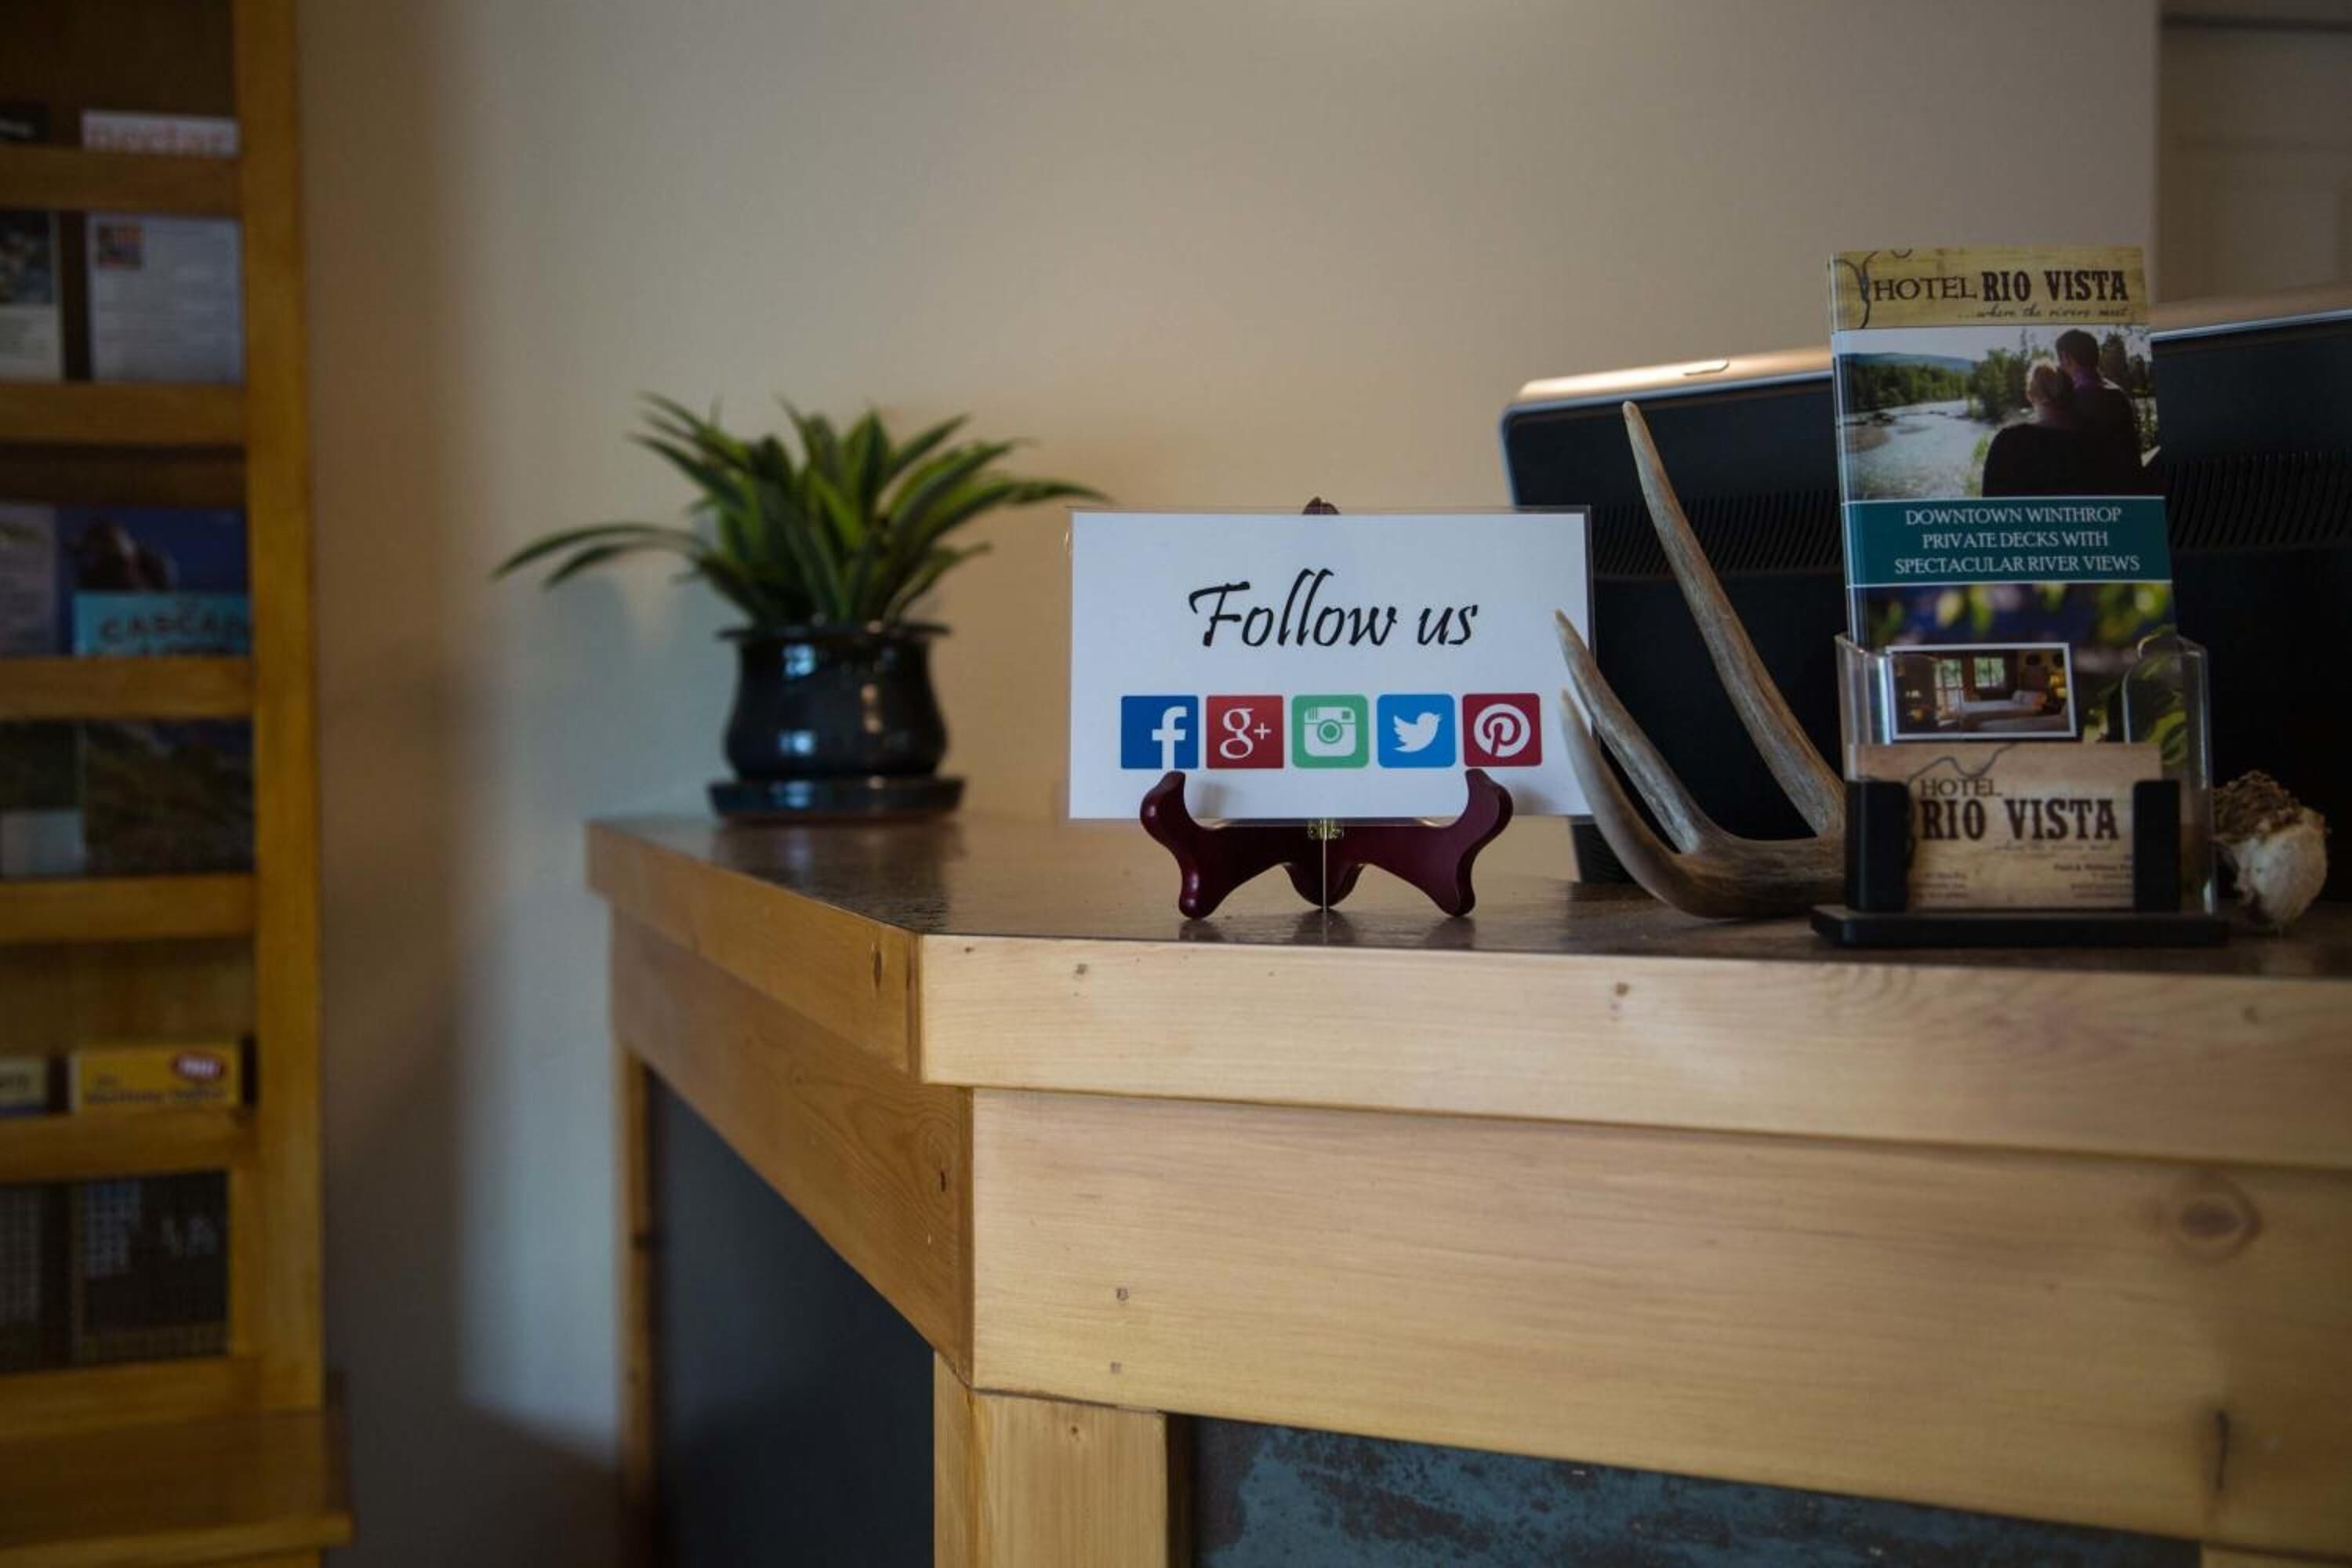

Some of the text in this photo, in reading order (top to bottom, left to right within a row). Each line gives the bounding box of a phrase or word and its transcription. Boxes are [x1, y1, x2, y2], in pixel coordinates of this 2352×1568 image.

[1874, 270, 2129, 302] HOTEL RIO VISTA
[1906, 506, 2122, 526] DOWNTOWN WINTHROP
[1922, 531, 2108, 549] PRIVATE DECKS WITH
[1894, 554, 2140, 575] SPECTACULAR RIVER VIEWS
[1189, 568, 1478, 647] Follow us
[1920, 778, 2002, 797] HOTEL
[1921, 797, 2120, 840] RIO VISTA
